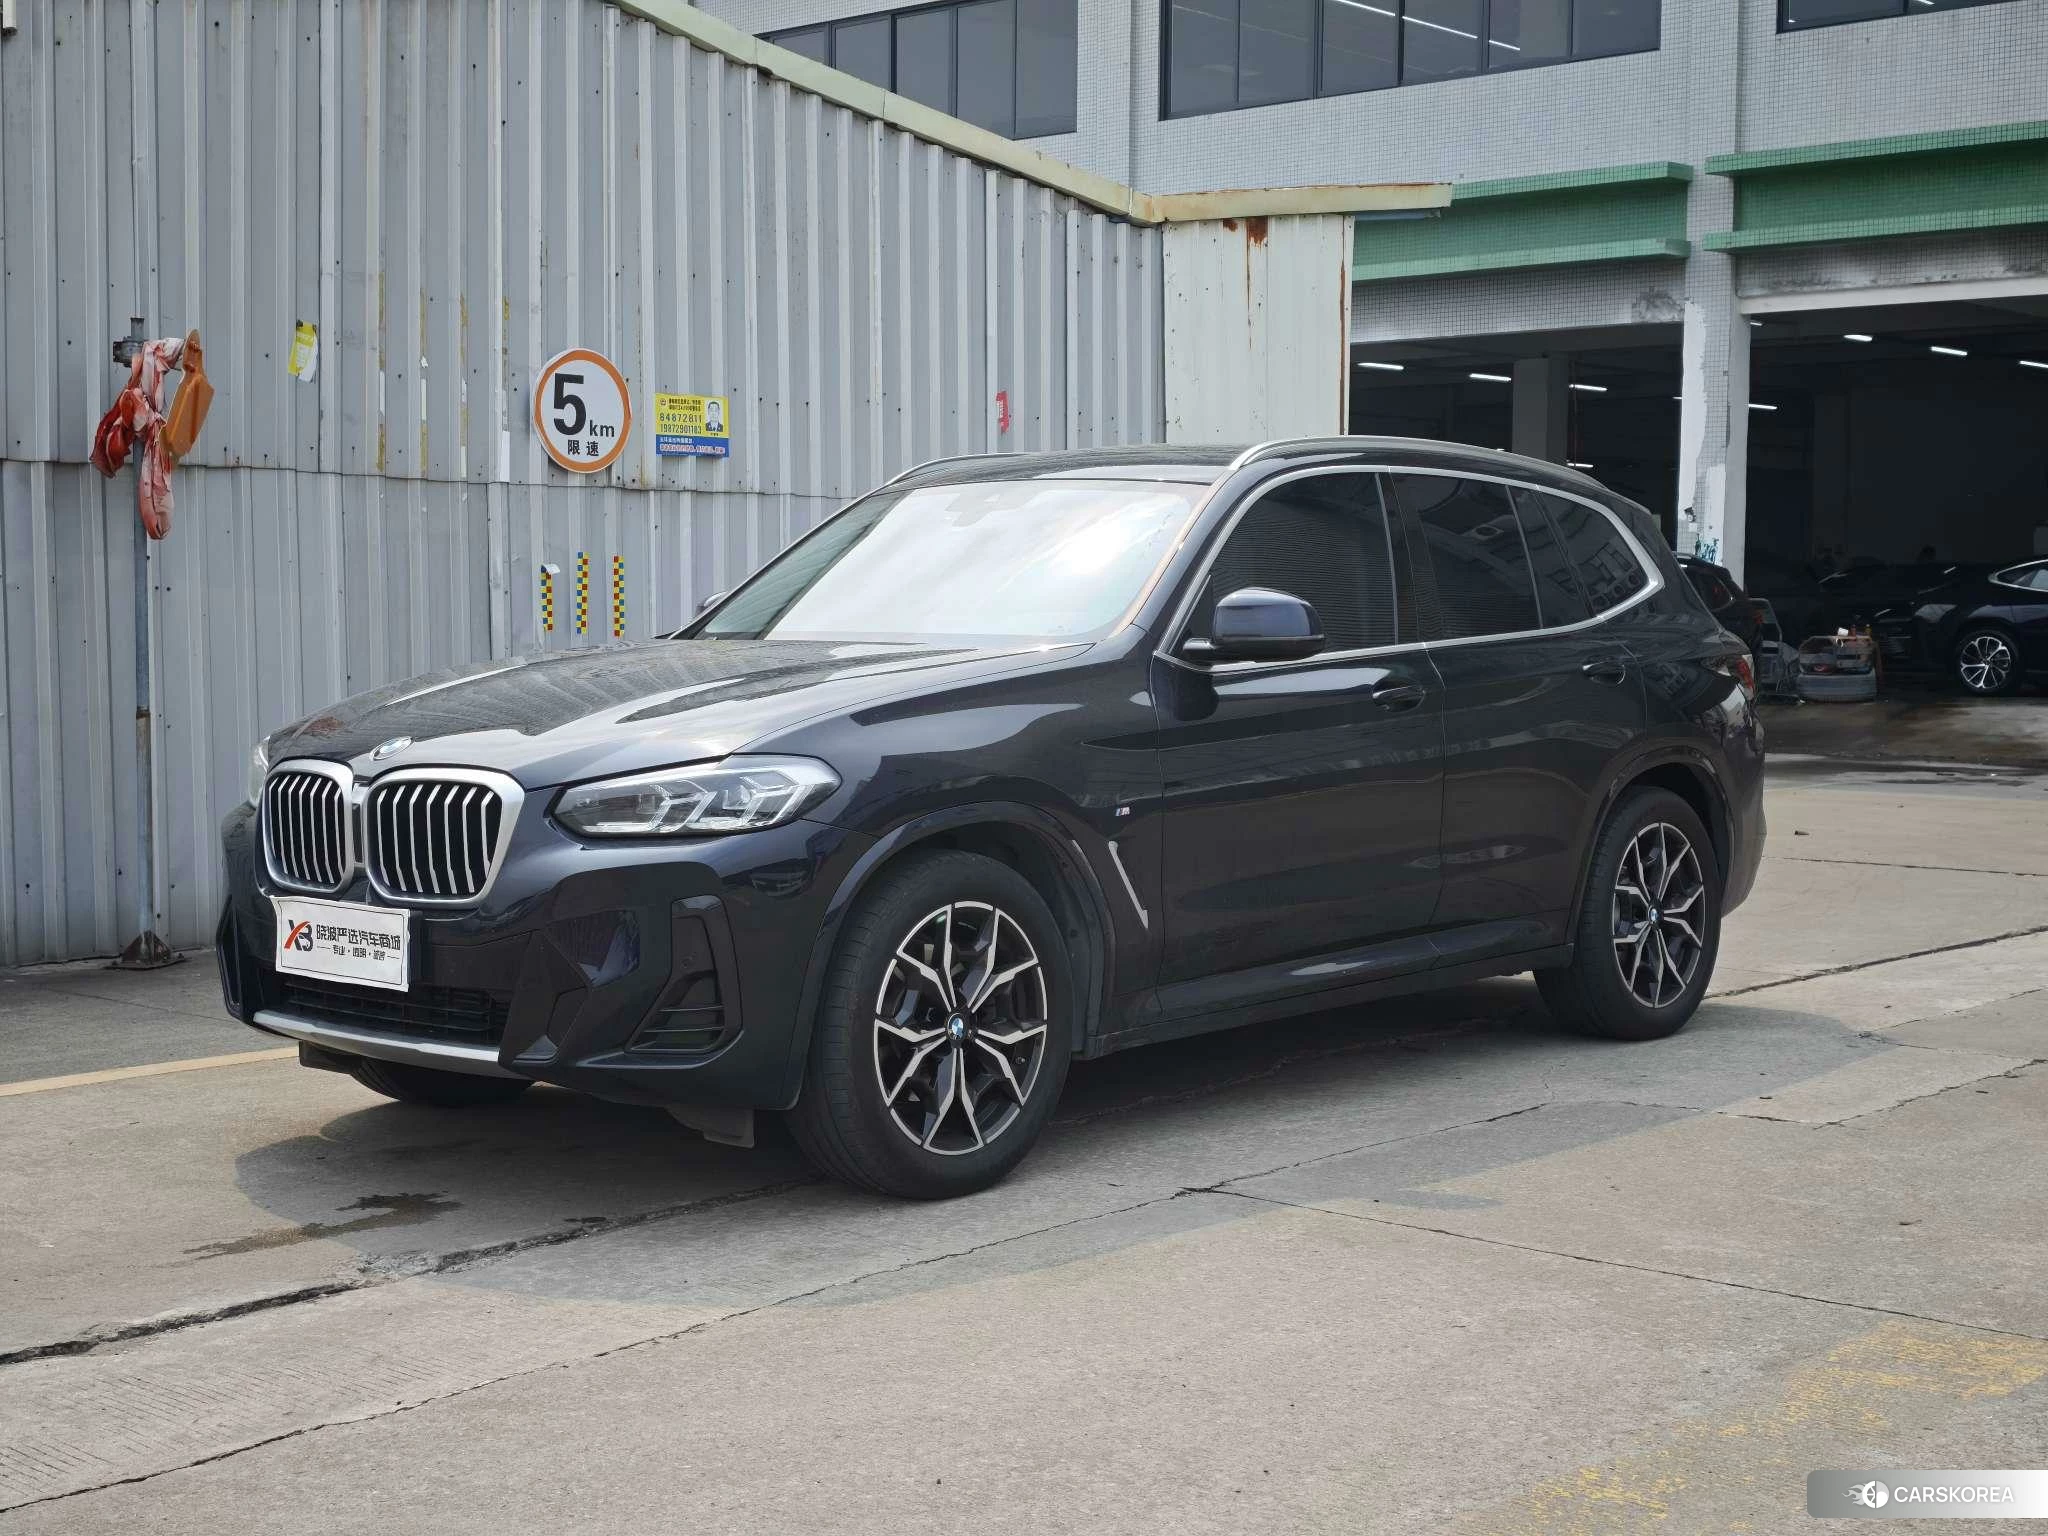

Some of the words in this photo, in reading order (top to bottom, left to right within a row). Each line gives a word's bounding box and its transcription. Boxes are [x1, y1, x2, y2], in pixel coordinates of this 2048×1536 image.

[553, 372, 587, 436] 5
[589, 419, 616, 438] km
[567, 439, 600, 457] 限速
[316, 924, 401, 951] 晓波严选汽车商城
